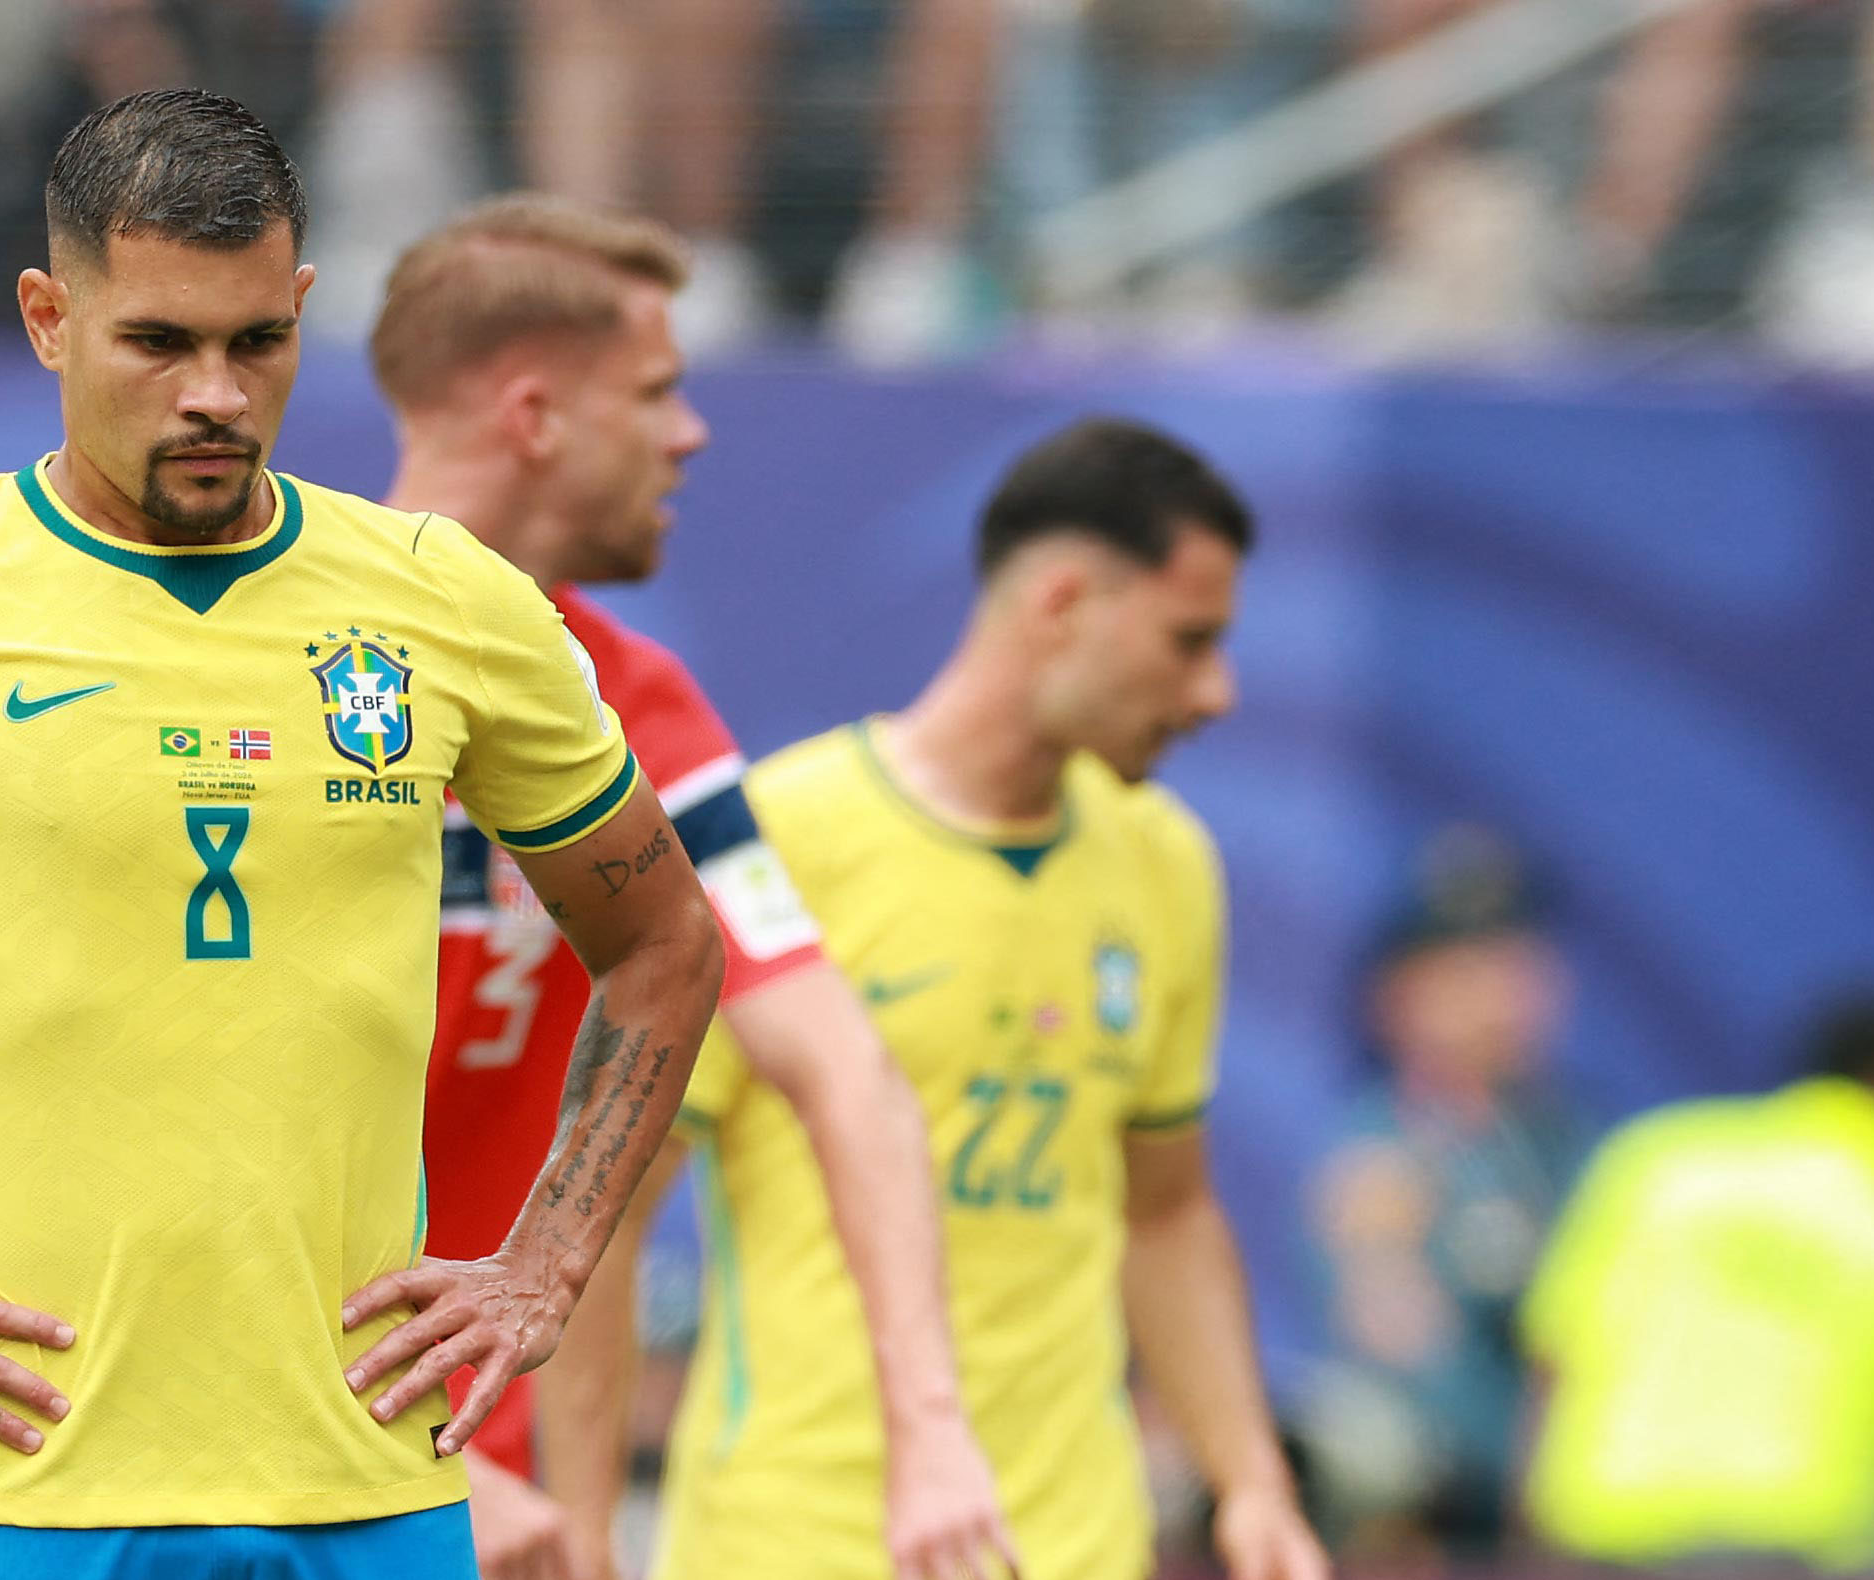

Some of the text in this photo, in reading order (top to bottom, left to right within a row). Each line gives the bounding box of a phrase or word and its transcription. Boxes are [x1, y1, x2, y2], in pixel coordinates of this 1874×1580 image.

[350, 695, 386, 711] CBF
[325, 780, 421, 805] BRASIL
[184, 804, 253, 961] 8
[591, 827, 671, 898] Deus
[945, 1072, 1069, 1209] 22
